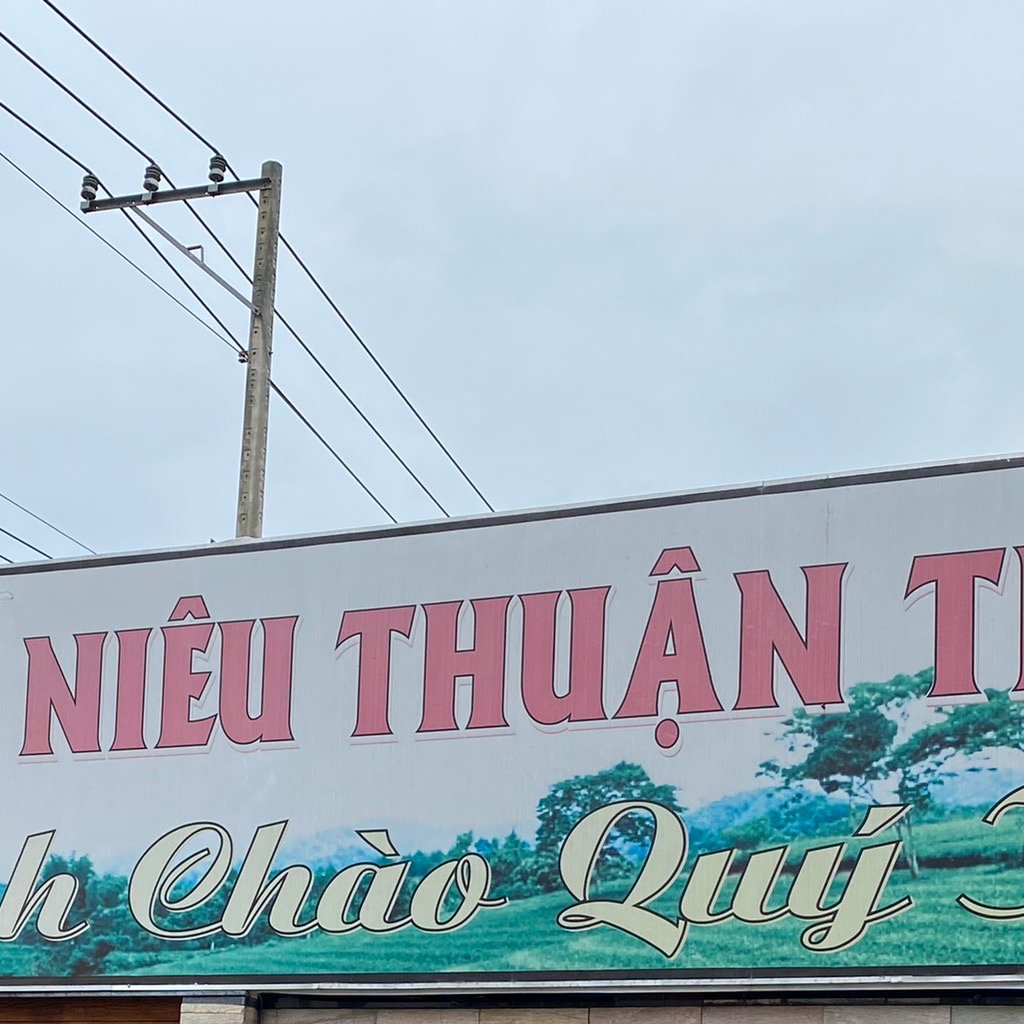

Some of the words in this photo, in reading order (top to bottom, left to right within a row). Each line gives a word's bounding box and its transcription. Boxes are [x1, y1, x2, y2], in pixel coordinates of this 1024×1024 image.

[19, 595, 299, 757] NIÊU
[335, 545, 849, 750] THUẬN
[903, 545, 1024, 699] T
[128, 820, 509, 940] Chào
[557, 799, 912, 959] Quý
